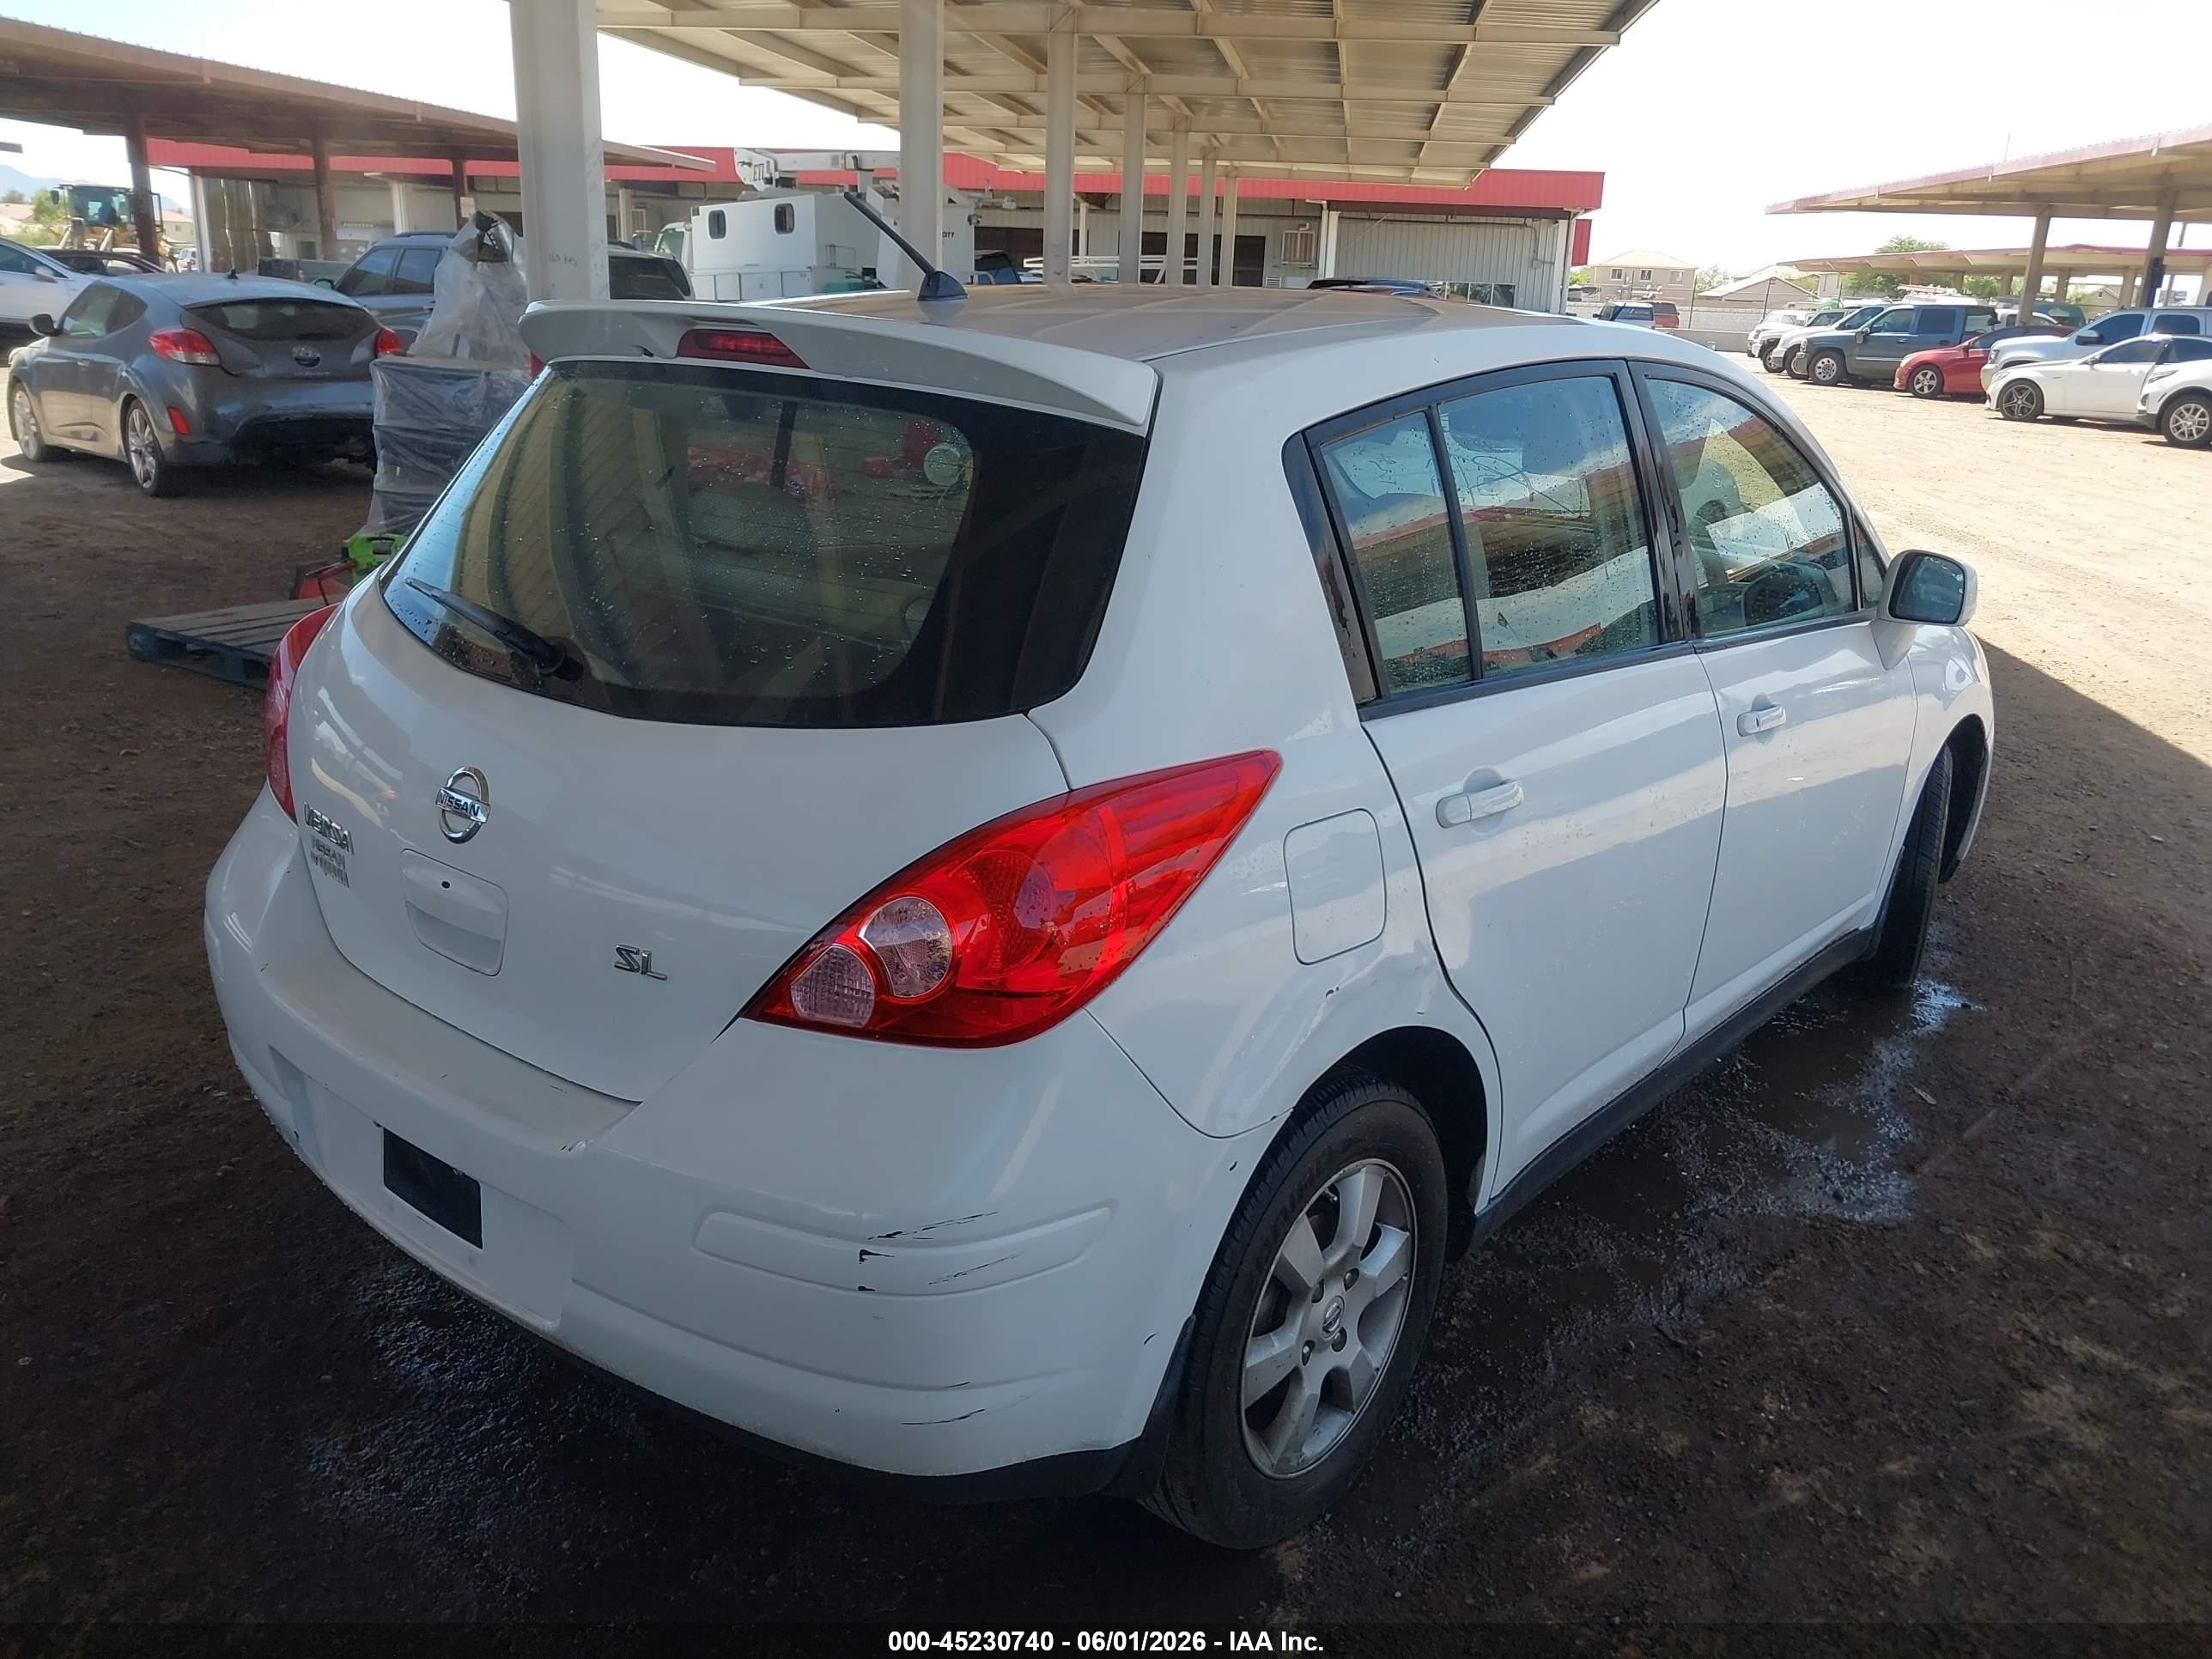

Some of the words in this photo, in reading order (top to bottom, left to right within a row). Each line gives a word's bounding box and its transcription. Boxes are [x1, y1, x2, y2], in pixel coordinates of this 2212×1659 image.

[438, 790, 480, 817] NISSAN
[304, 801, 355, 856] VERSA
[614, 944, 668, 981] SL
